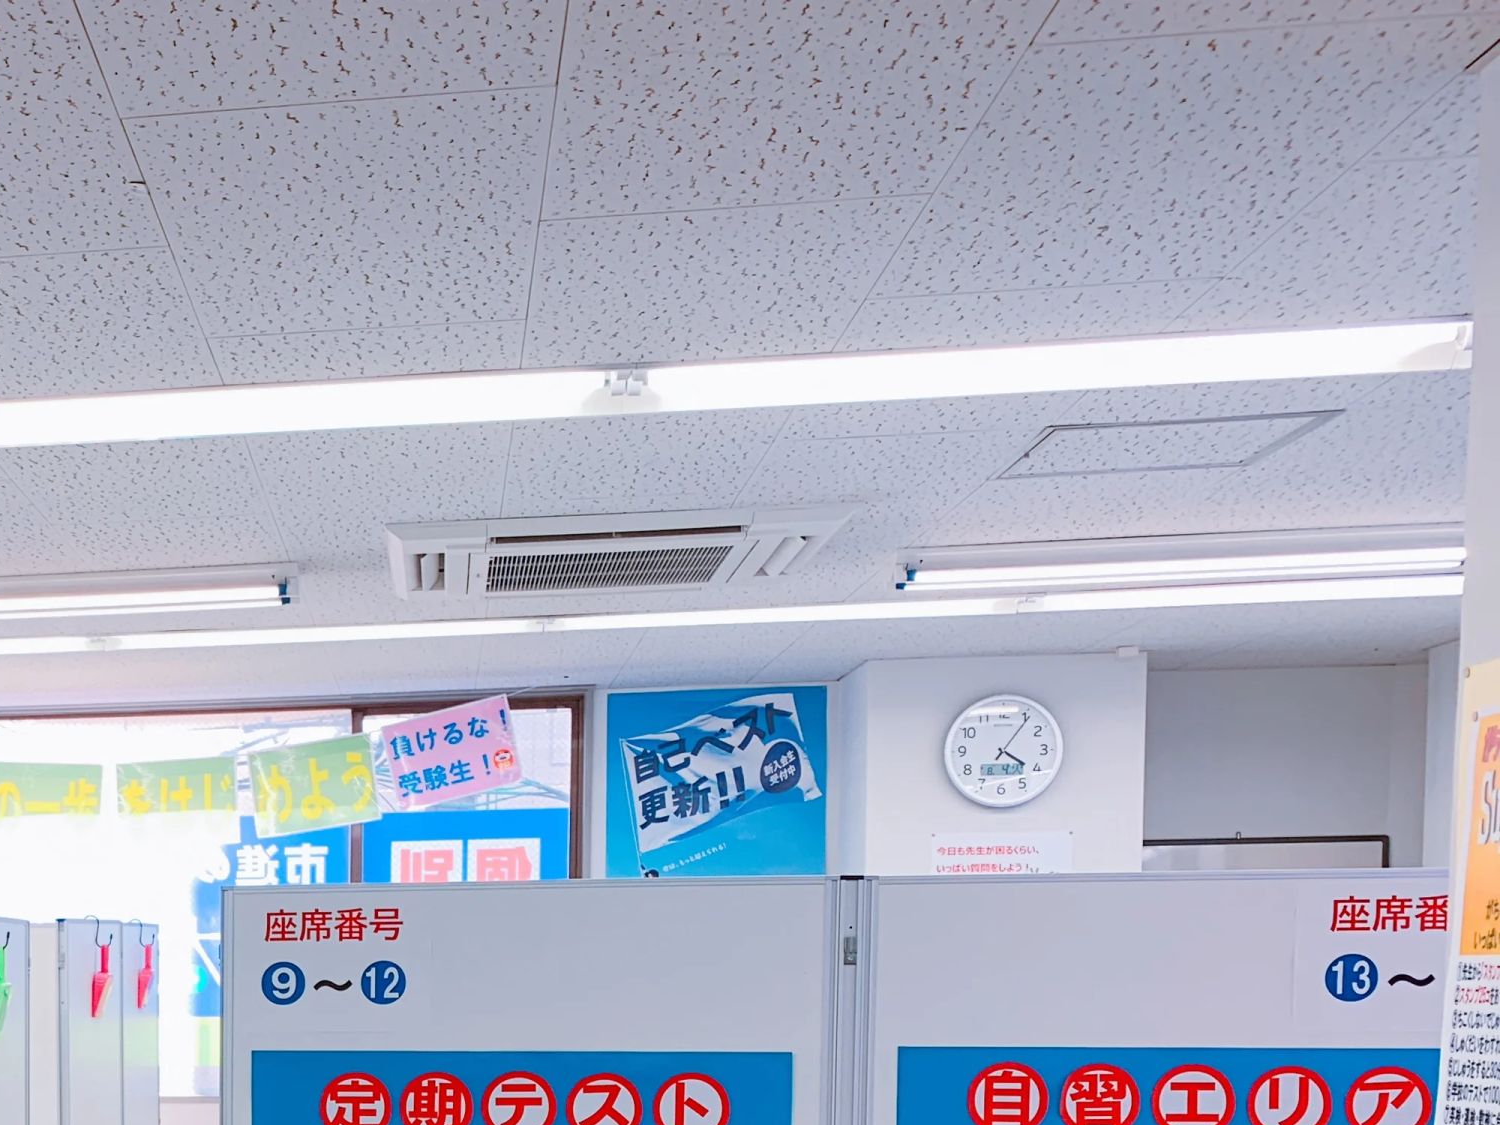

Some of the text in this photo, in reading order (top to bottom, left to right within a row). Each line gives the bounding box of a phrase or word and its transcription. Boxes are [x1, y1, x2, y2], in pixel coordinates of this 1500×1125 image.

[389, 709, 509, 760] 負けるな！
[962, 727, 976, 738] 10
[1033, 725, 1042, 737] 2
[634, 702, 793, 784] 自己ベスト
[958, 746, 967, 757] 9
[1040, 744, 1049, 756] 3
[764, 750, 797, 777] 新入会生
[963, 764, 972, 775] 8
[398, 754, 492, 798] 受験生！
[769, 765, 797, 787] 受付中
[1018, 777, 1027, 789] 5
[996, 784, 1006, 795] 6
[1330, 894, 1448, 932] 座席番
[263, 908, 404, 943] 座席番号
